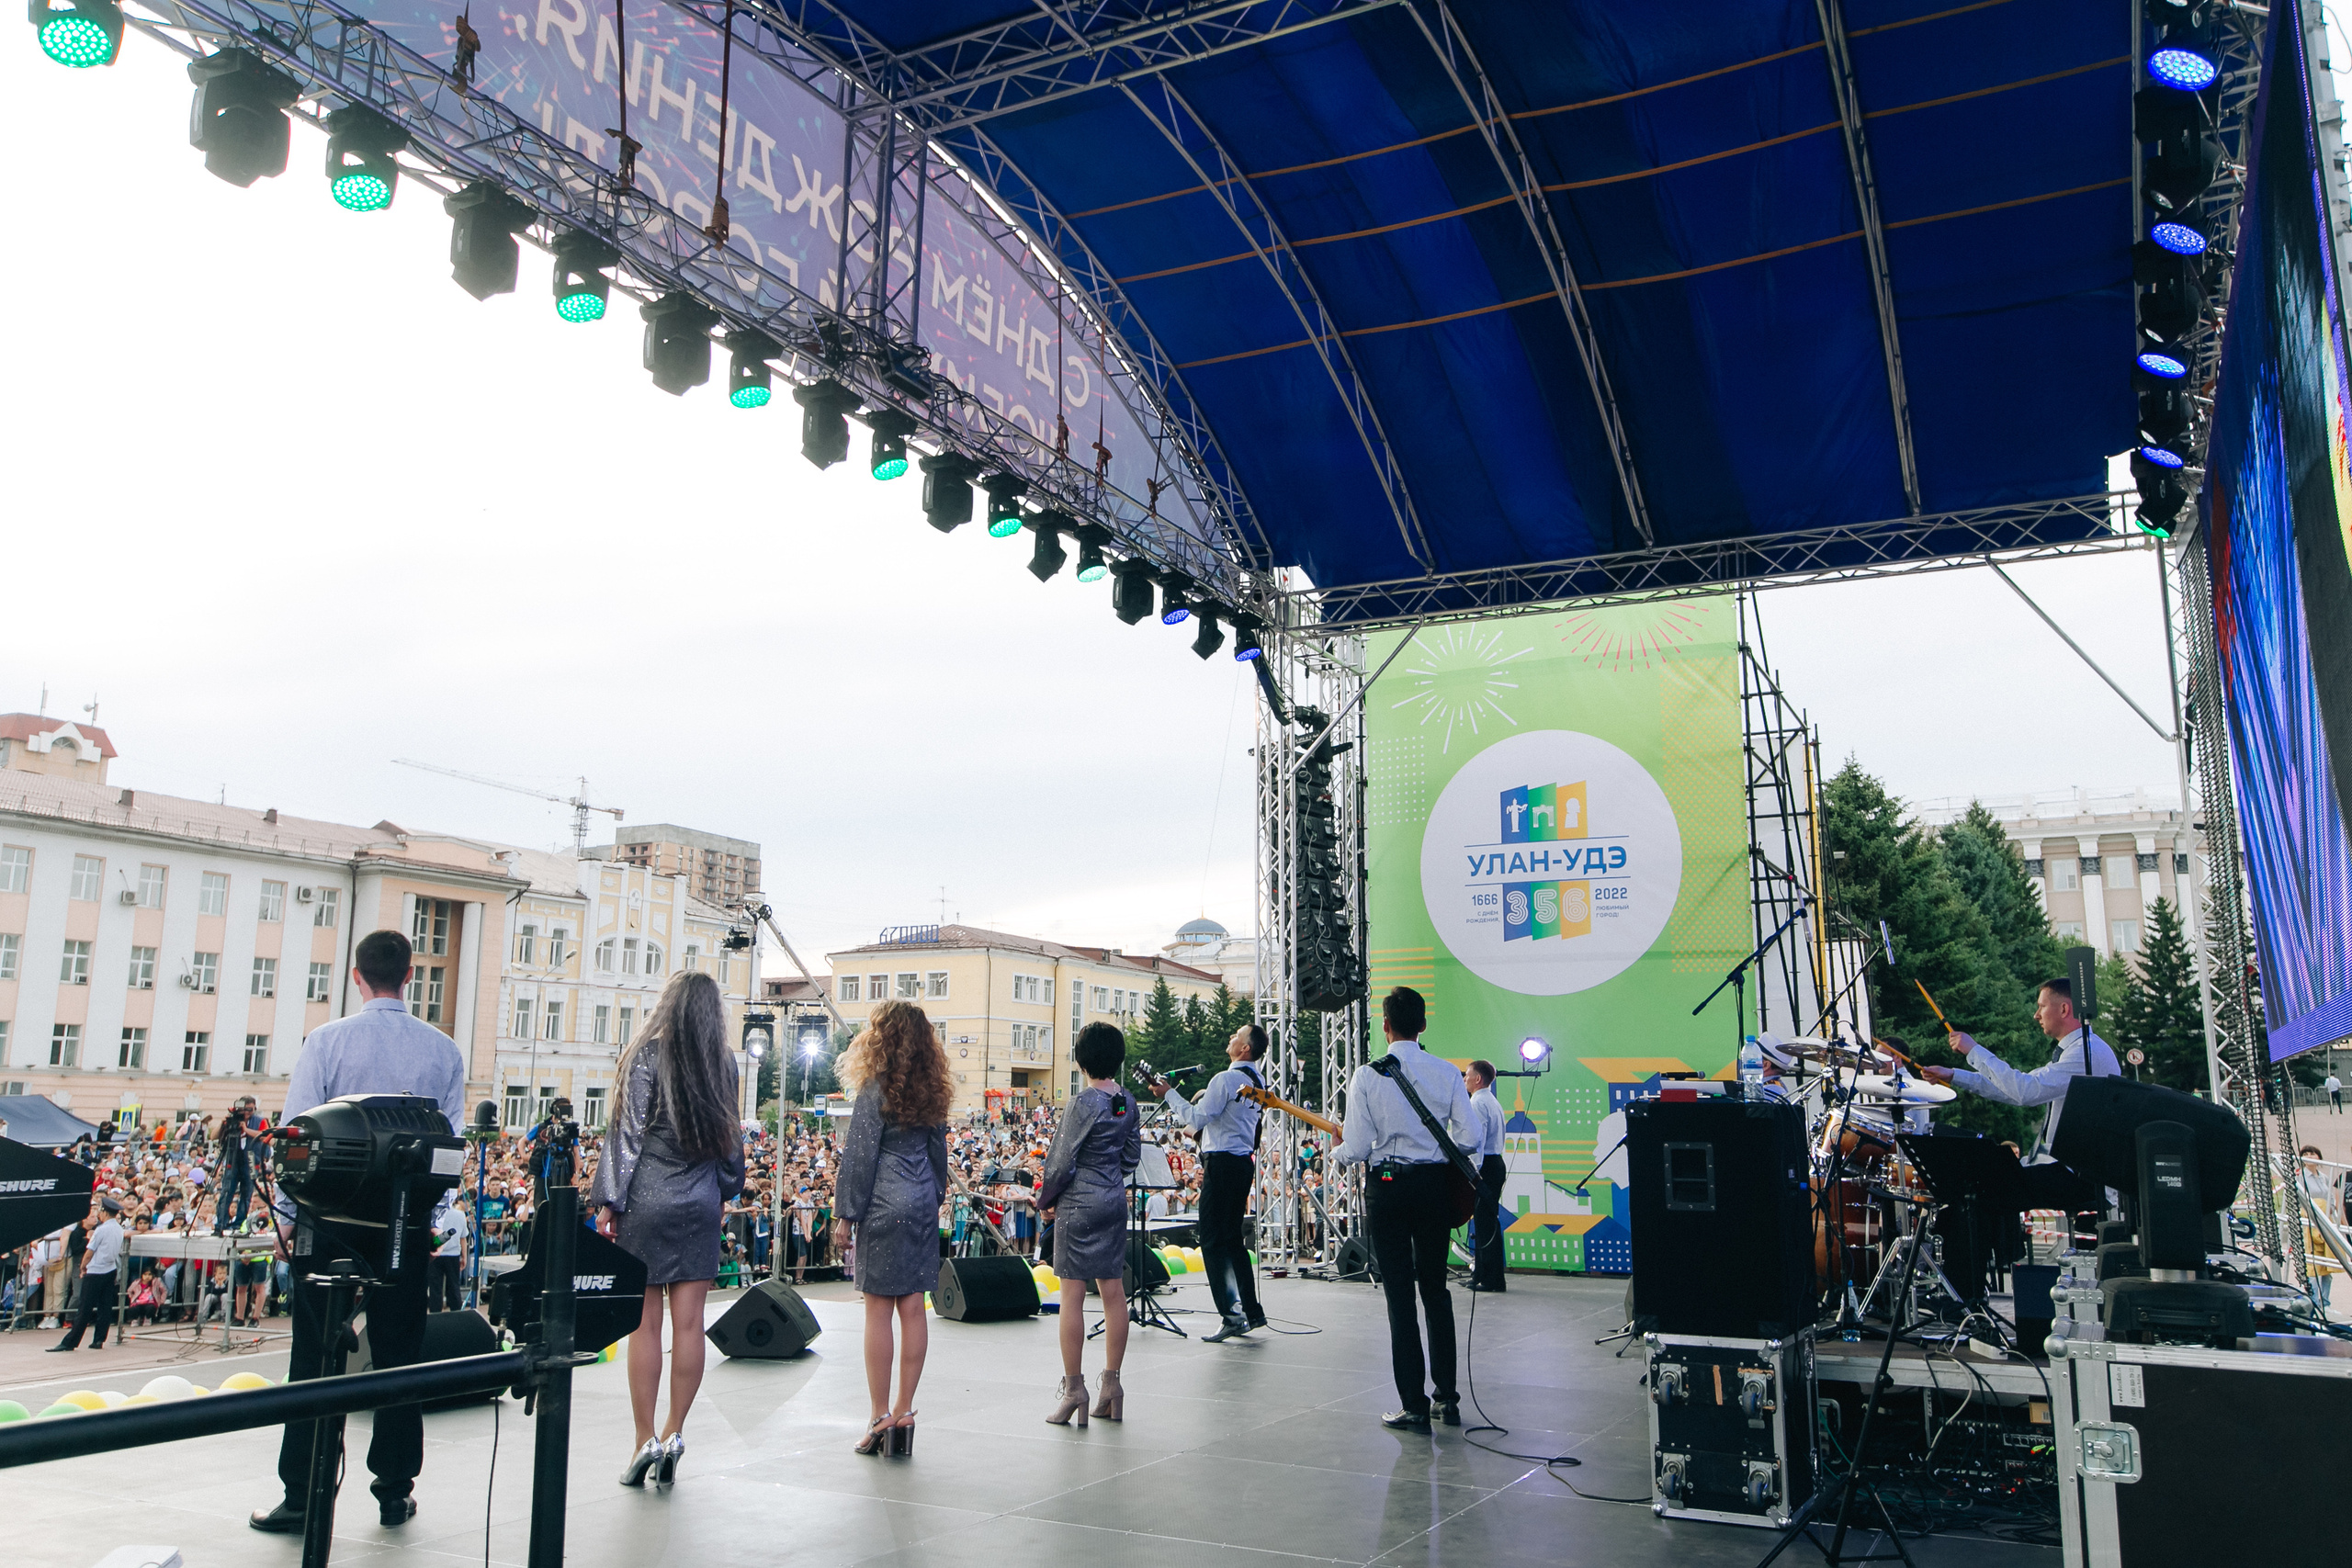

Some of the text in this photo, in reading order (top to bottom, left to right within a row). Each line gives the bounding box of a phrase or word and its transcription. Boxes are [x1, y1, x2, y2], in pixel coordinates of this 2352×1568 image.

[1467, 846, 1627, 877] УЛАН-УДЭ
[1472, 893, 1498, 907] 1666
[1595, 886, 1628, 900] 2022
[1506, 887, 1589, 925] 356
[879, 924, 939, 944] 670000
[0, 1179, 56, 1192] SHURE
[573, 1275, 615, 1291] HURE
